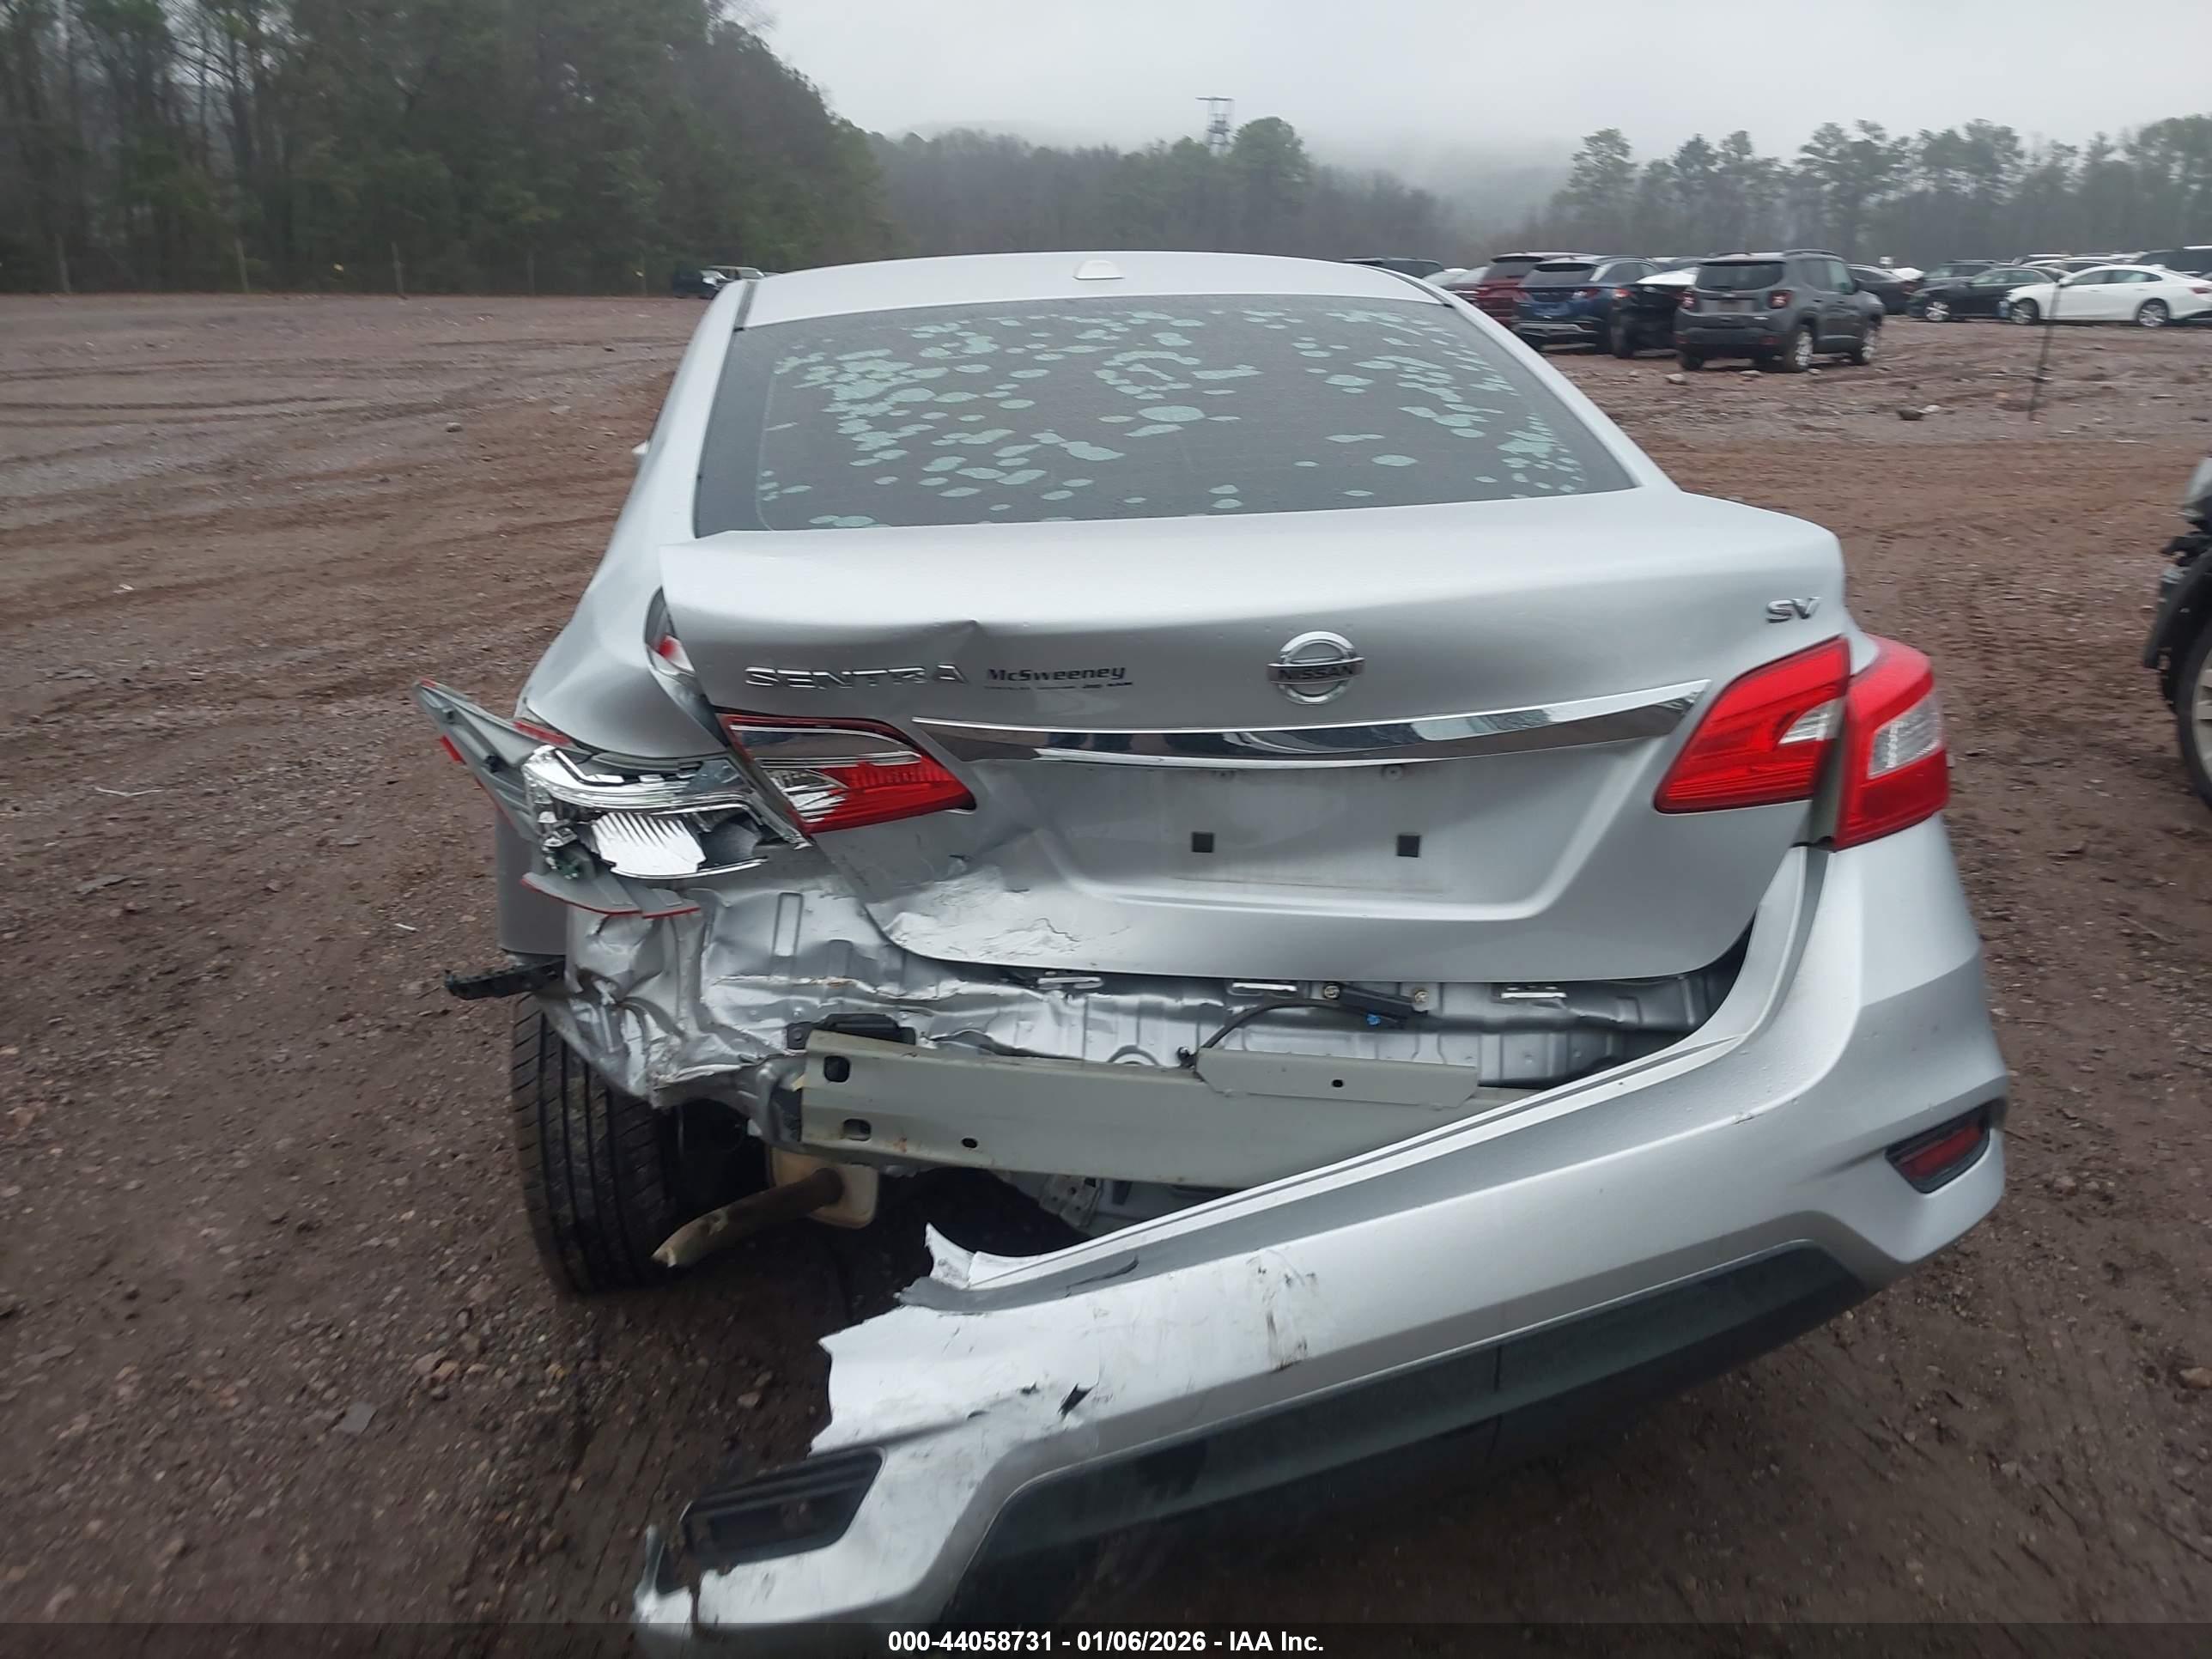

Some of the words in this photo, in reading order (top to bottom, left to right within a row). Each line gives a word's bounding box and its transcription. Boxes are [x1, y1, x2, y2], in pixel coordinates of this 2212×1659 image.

[1765, 596, 1821, 623] SV
[744, 664, 967, 690] SENTRA
[988, 667, 1126, 681] McSweeney
[1278, 665, 1353, 680] NSSAN
